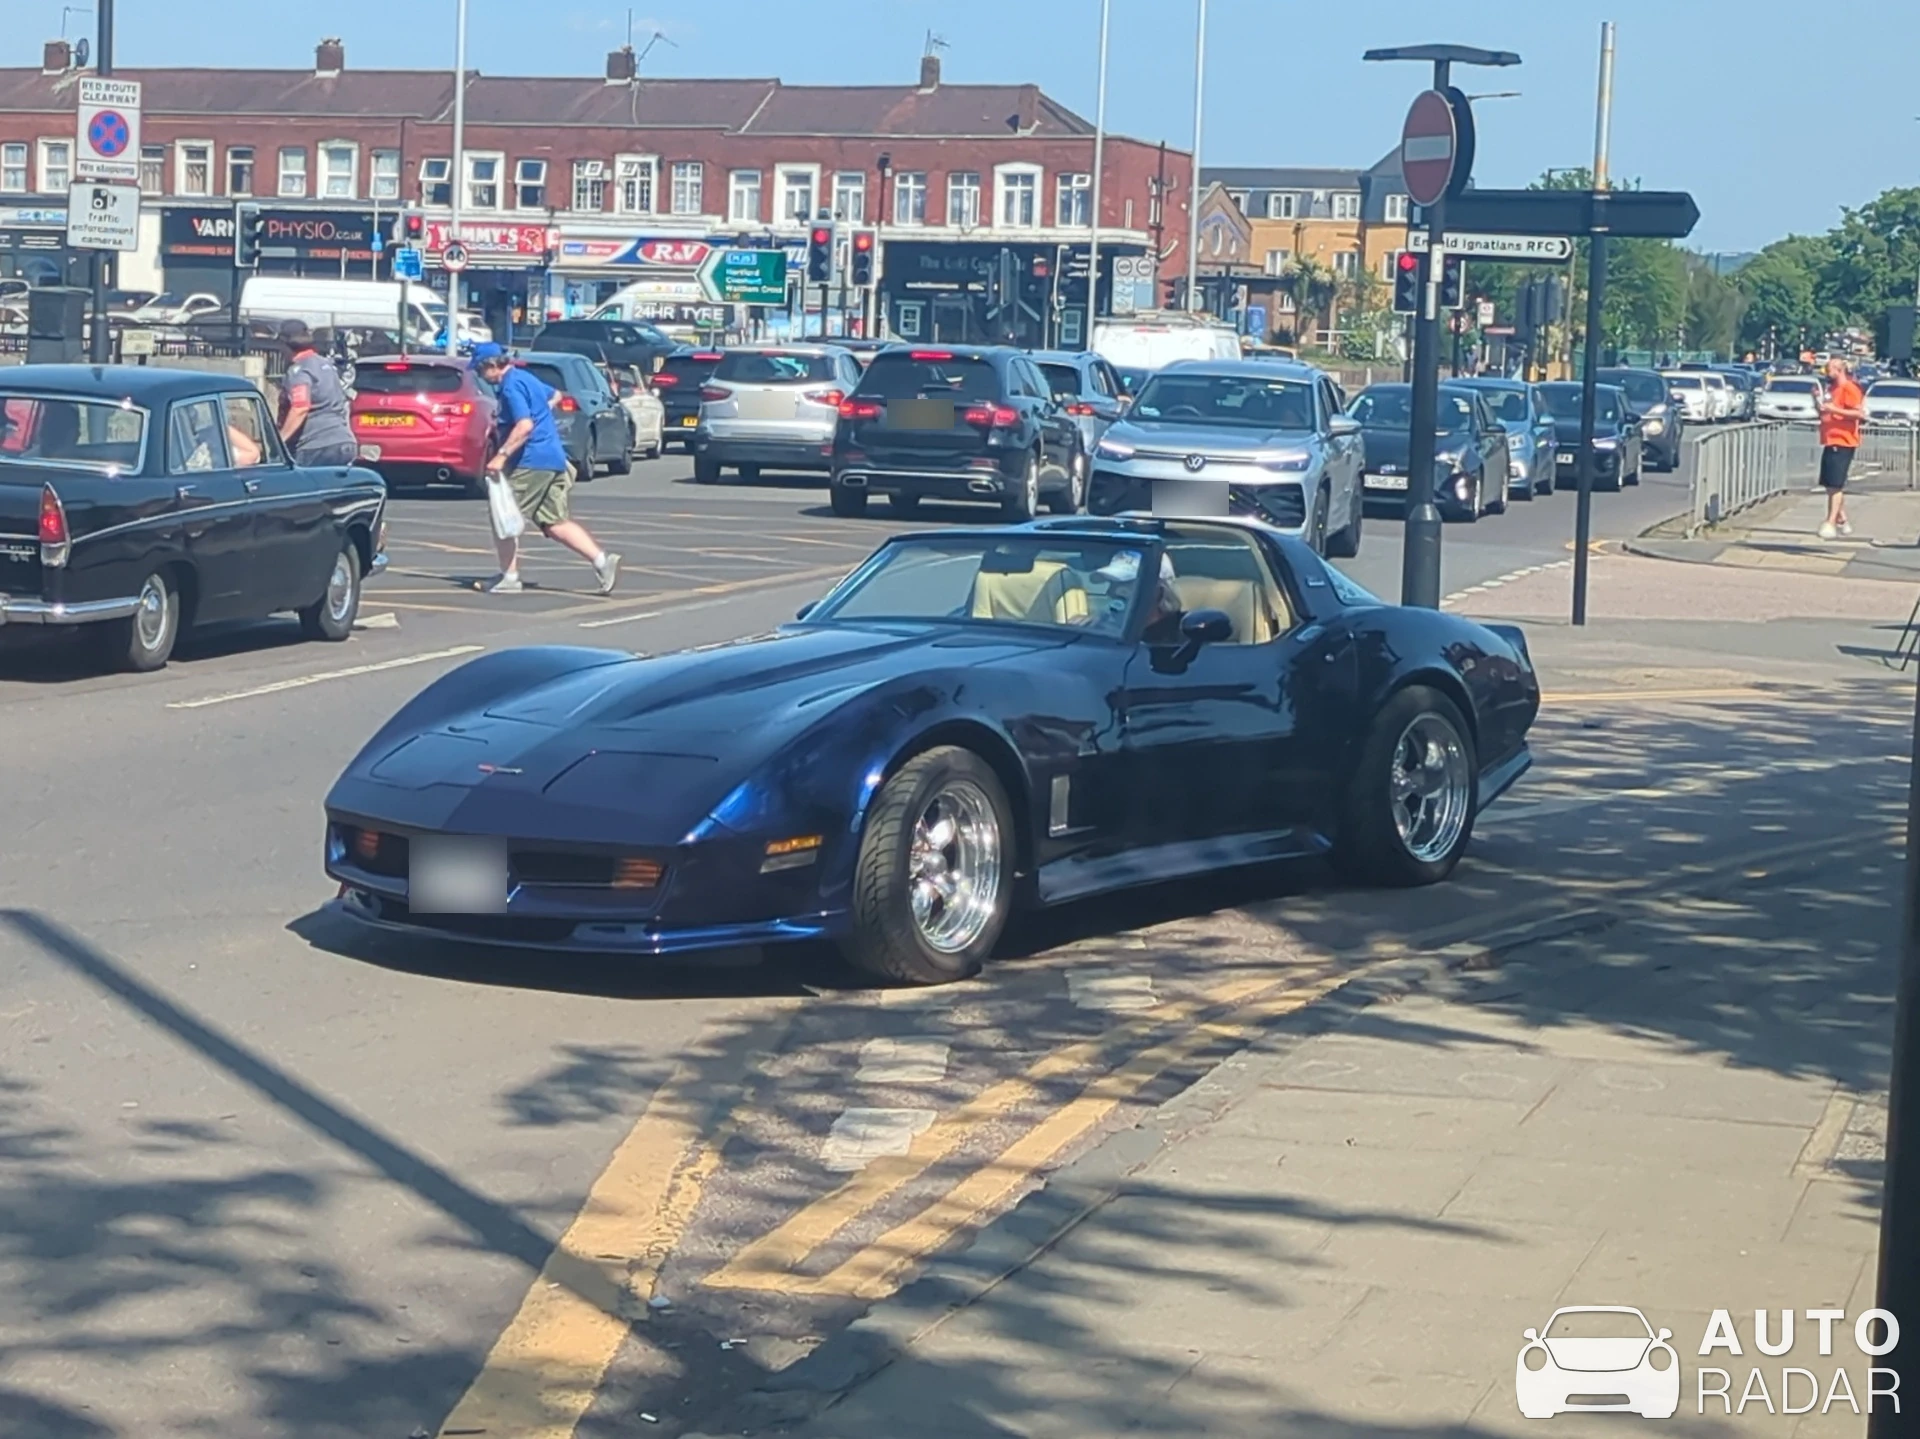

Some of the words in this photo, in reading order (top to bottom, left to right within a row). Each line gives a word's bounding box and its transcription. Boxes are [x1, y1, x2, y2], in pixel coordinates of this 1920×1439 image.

[82, 82, 102, 90] RED
[105, 84, 137, 93] ROUTE
[82, 93, 137, 103] CLEARWAY
[1413, 236, 1458, 249] Enld
[1527, 241, 1554, 252] RFC
[651, 243, 700, 261] R&V
